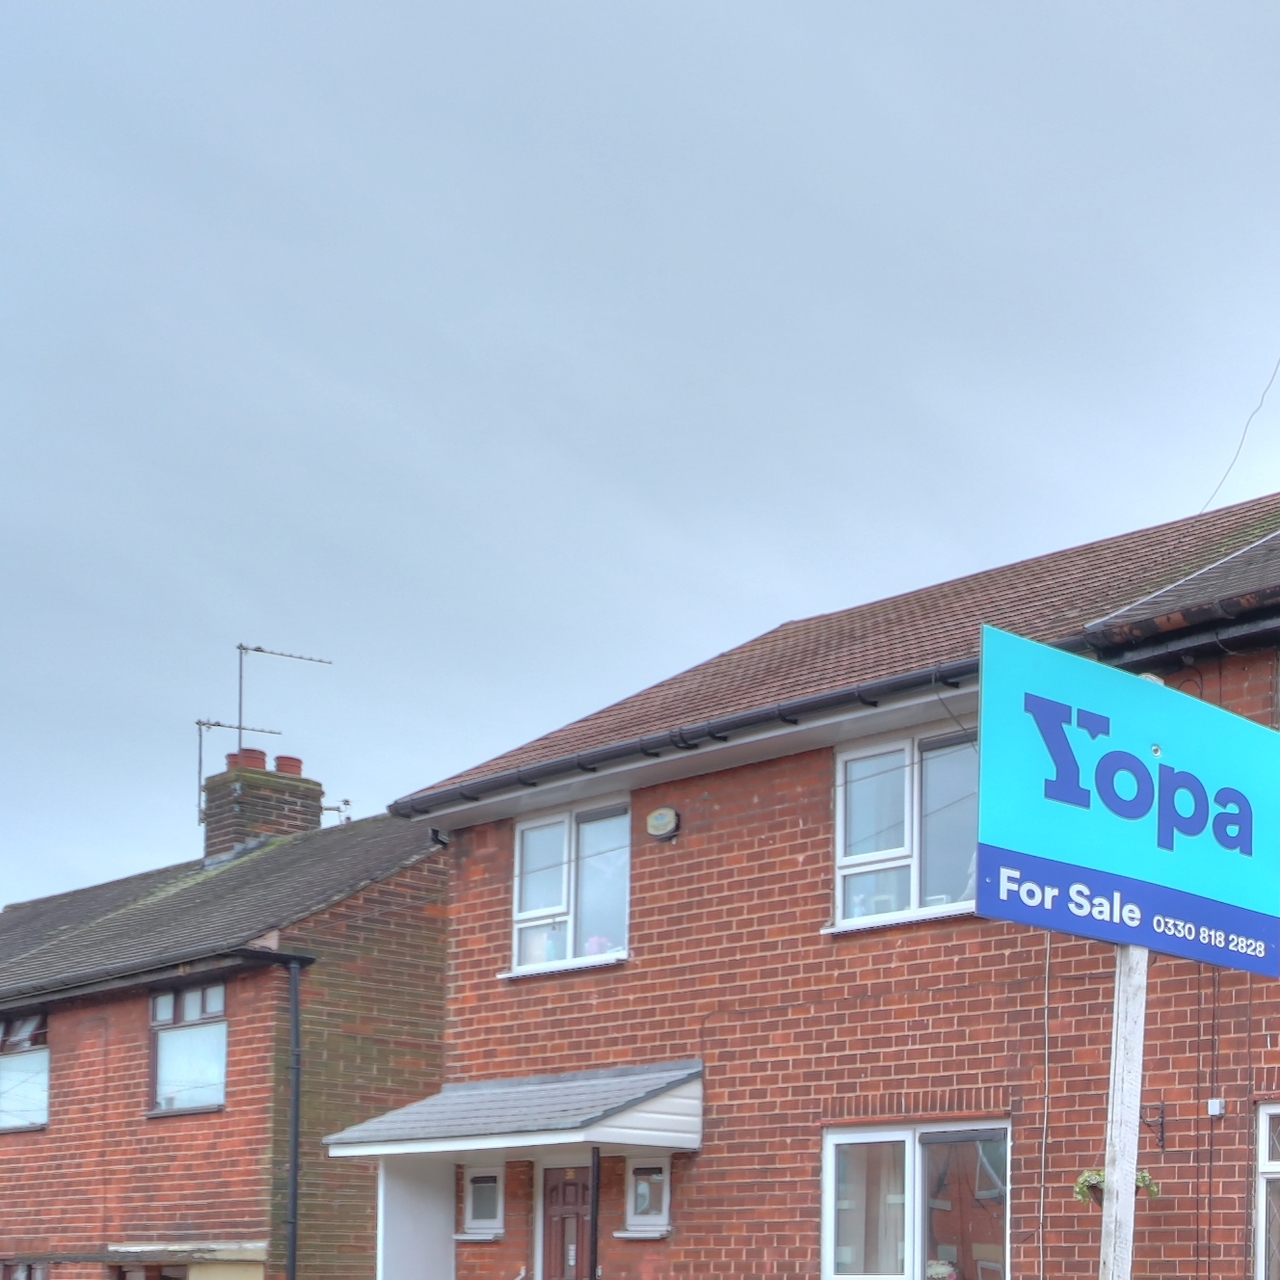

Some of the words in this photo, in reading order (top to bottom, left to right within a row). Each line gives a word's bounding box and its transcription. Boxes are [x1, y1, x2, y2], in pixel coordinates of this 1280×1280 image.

[1023, 692, 1253, 858] Yopa
[999, 866, 1060, 911] For
[1067, 882, 1142, 928] Sale
[1153, 915, 1196, 941] 0330
[1199, 927, 1225, 949] 818
[1228, 934, 1266, 958] 2828
